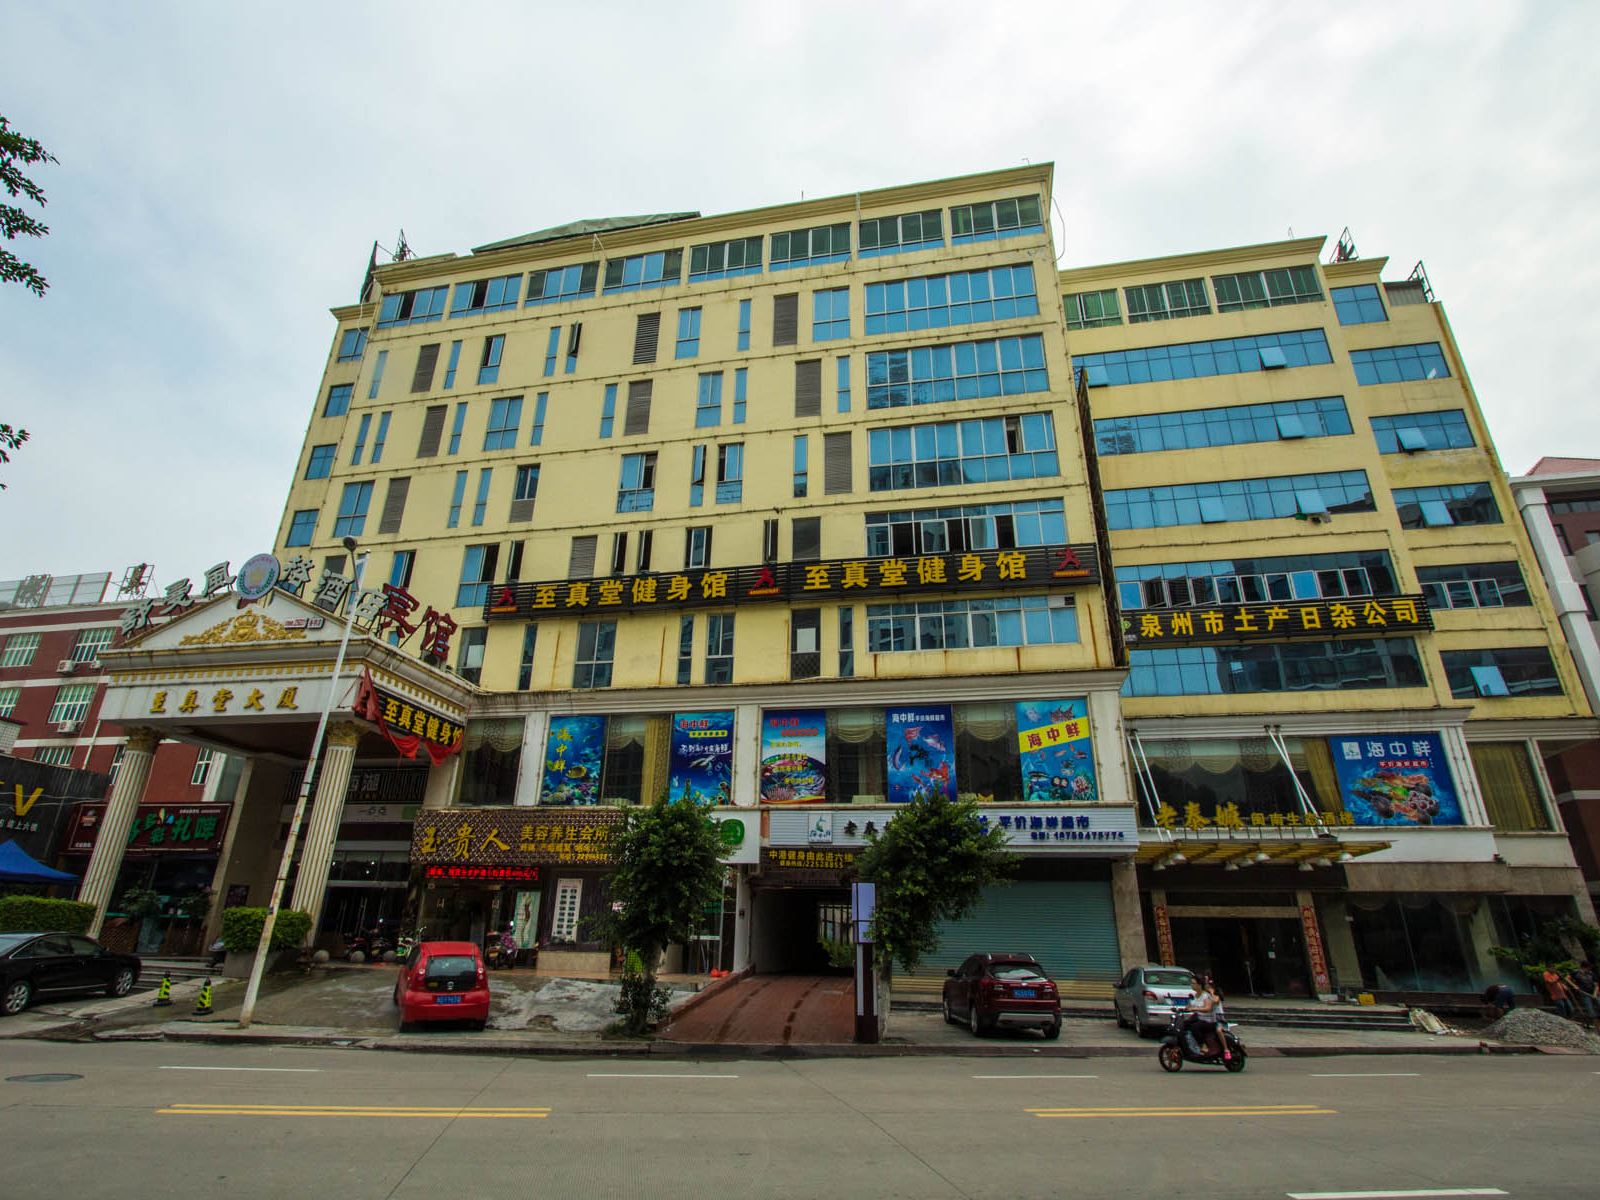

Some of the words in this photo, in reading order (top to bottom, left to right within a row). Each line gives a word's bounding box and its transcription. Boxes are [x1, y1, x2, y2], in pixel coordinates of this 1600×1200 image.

[803, 551, 1028, 591] 至真堂健身馆
[532, 572, 728, 609] 至真堂健身馆
[1139, 600, 1419, 639] 泉州市土产日杂公司
[150, 686, 298, 714] 至真堂大厦
[1026, 721, 1080, 749] 海中鲜
[1365, 740, 1432, 757] 海中鲜
[520, 824, 609, 842] 美容养生会所
